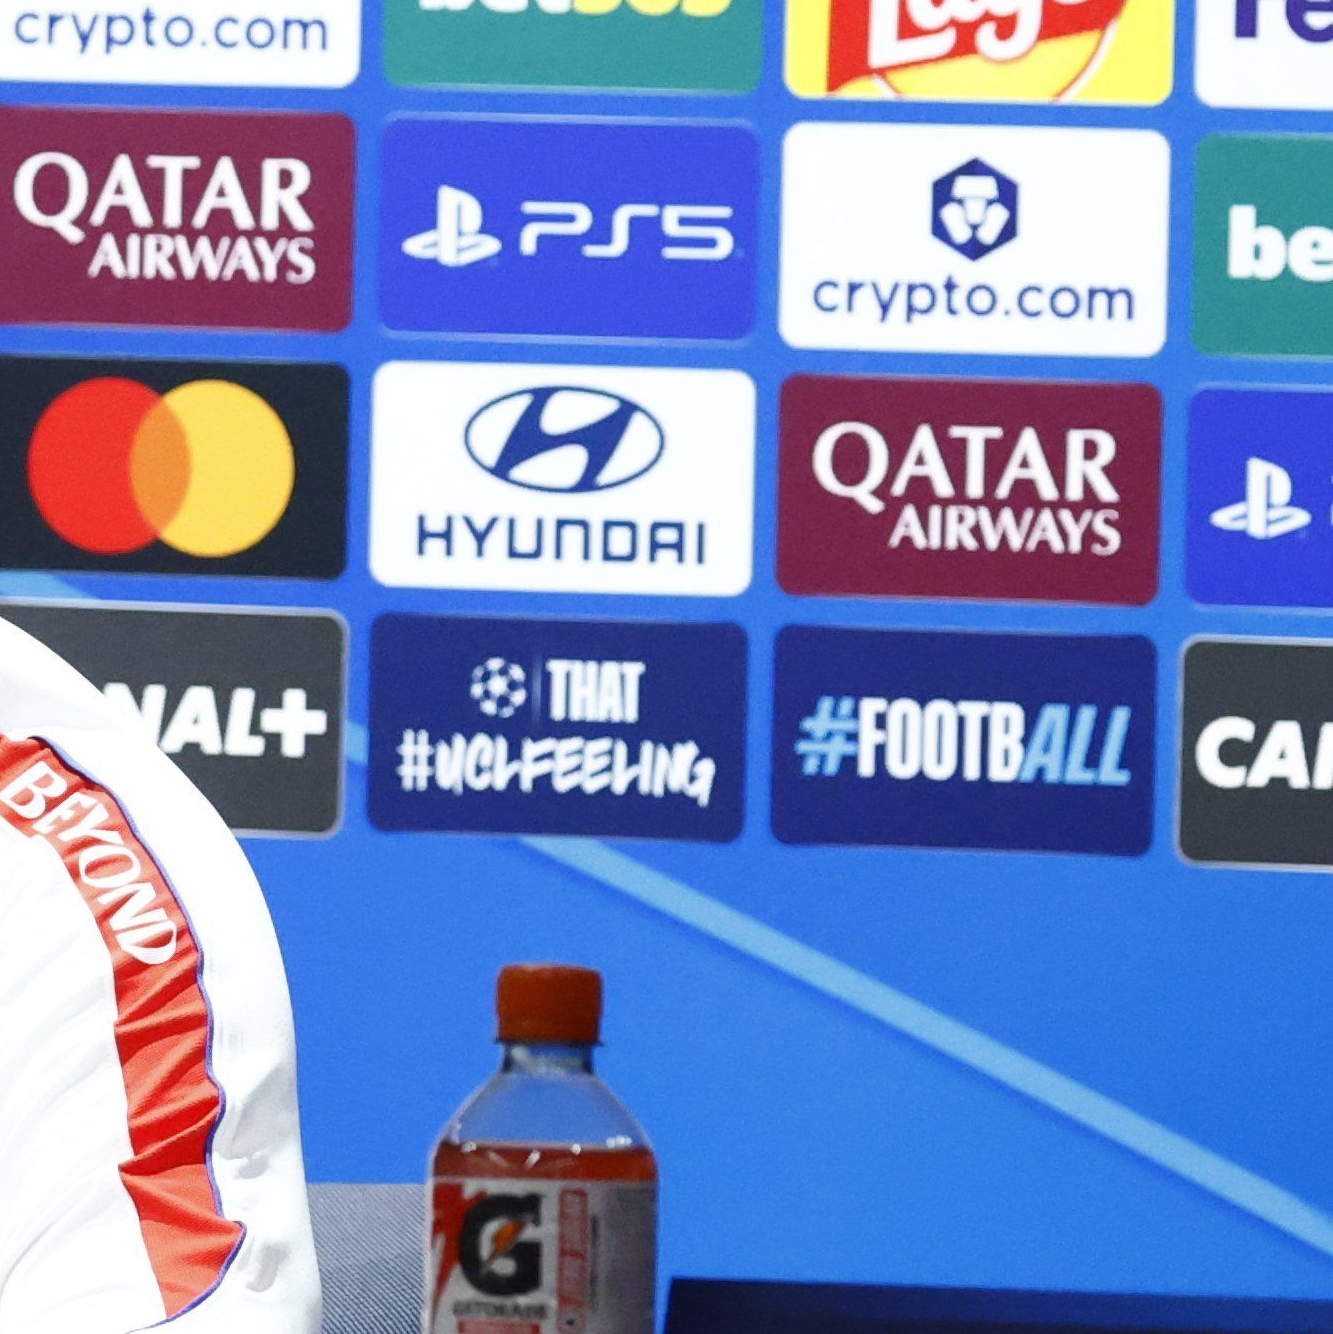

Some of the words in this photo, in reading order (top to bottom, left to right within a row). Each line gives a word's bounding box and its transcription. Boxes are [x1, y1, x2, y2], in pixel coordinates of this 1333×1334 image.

[14, 7, 328, 54] crypto.com
[13, 152, 315, 245] QATAR
[88, 234, 318, 285] AIRWAYS
[520, 201, 734, 260] PS5
[813, 275, 1134, 323] crypto.com
[811, 420, 1120, 505] QATAR
[417, 514, 705, 565] HYUNDAI
[888, 505, 1123, 557] AIRWAYS
[546, 659, 645, 723] THAT
[398, 729, 715, 806] #UCLFEELING
[796, 697, 1130, 784] #FOOTBALL
[458, 1194, 541, 1297] G
